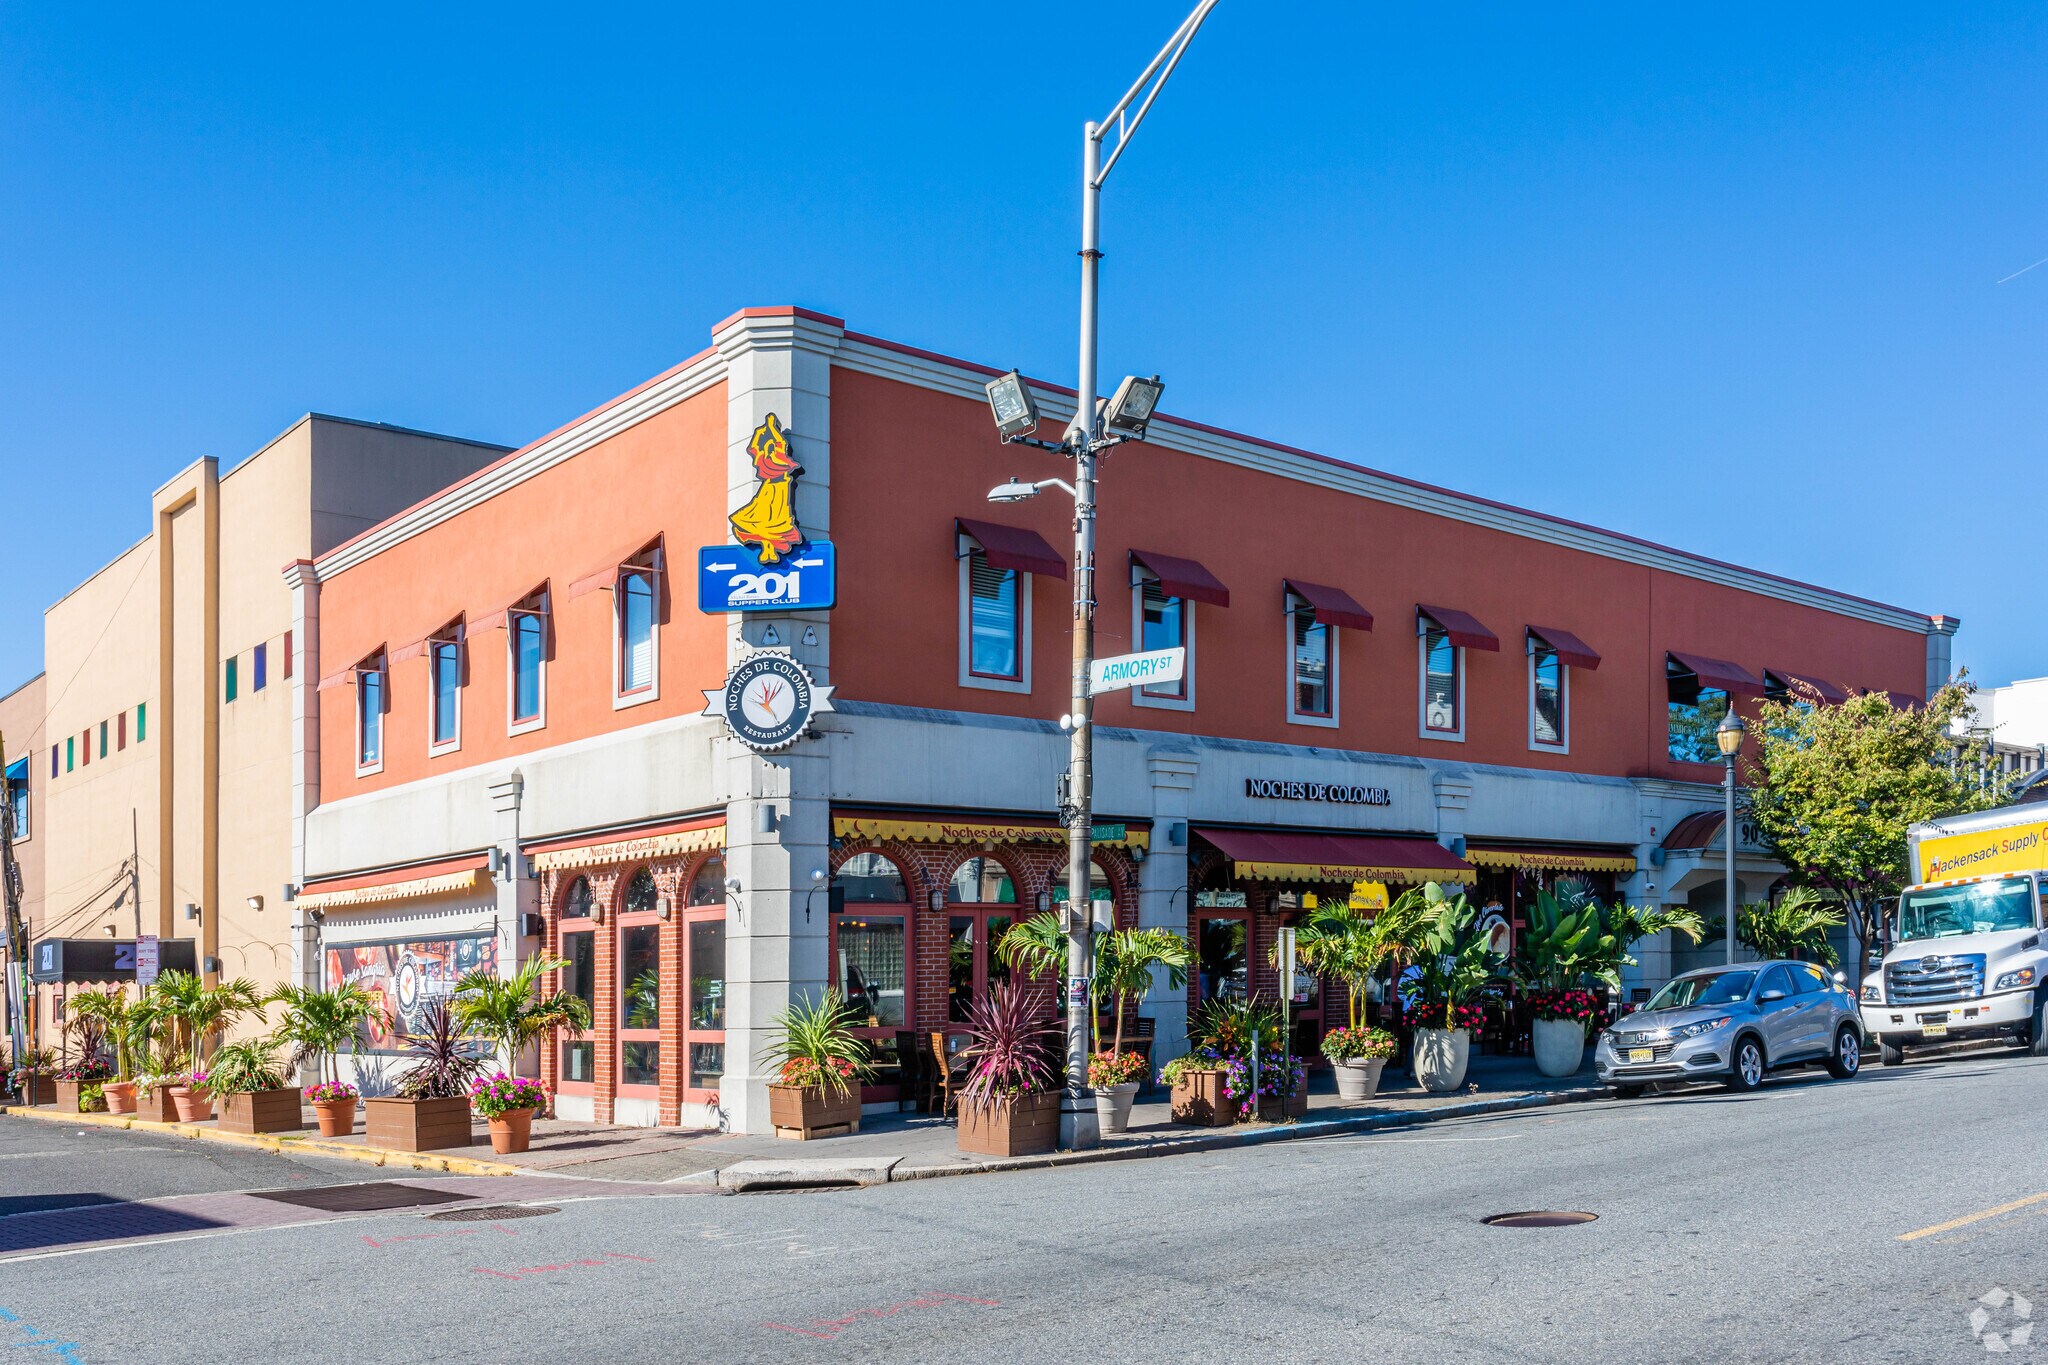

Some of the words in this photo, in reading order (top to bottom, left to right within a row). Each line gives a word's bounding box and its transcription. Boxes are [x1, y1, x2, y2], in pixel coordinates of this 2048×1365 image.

[728, 571, 800, 601] 201
[728, 599, 769, 607] SUPPER
[771, 597, 800, 605] CLUB
[1102, 657, 1159, 682] ARMORY
[1159, 656, 1173, 669] ST
[728, 667, 753, 711] NOCHES
[754, 661, 770, 673] DE
[773, 661, 808, 710] COLOMBIA
[743, 723, 792, 739] RESTAURANT
[1249, 779, 1305, 799] NOCHES
[1309, 784, 1327, 800] DE
[1329, 785, 1392, 805] COLOMBIA
[941, 825, 991, 838] Noches
[992, 825, 1004, 838] de
[1006, 827, 1064, 839] Colombia
[588, 846, 613, 858] Noches
[615, 844, 624, 854] de
[626, 838, 660, 853] Colombia
[1928, 843, 1998, 880] Hackensack
[2001, 832, 2039, 853] Supply
[1520, 854, 1545, 864] Noches
[1545, 856, 1554, 865] de
[1554, 857, 1586, 867] Colombia
[1320, 866, 1352, 878] Noches
[1353, 868, 1364, 878] de
[1365, 868, 1406, 880] Colombia
